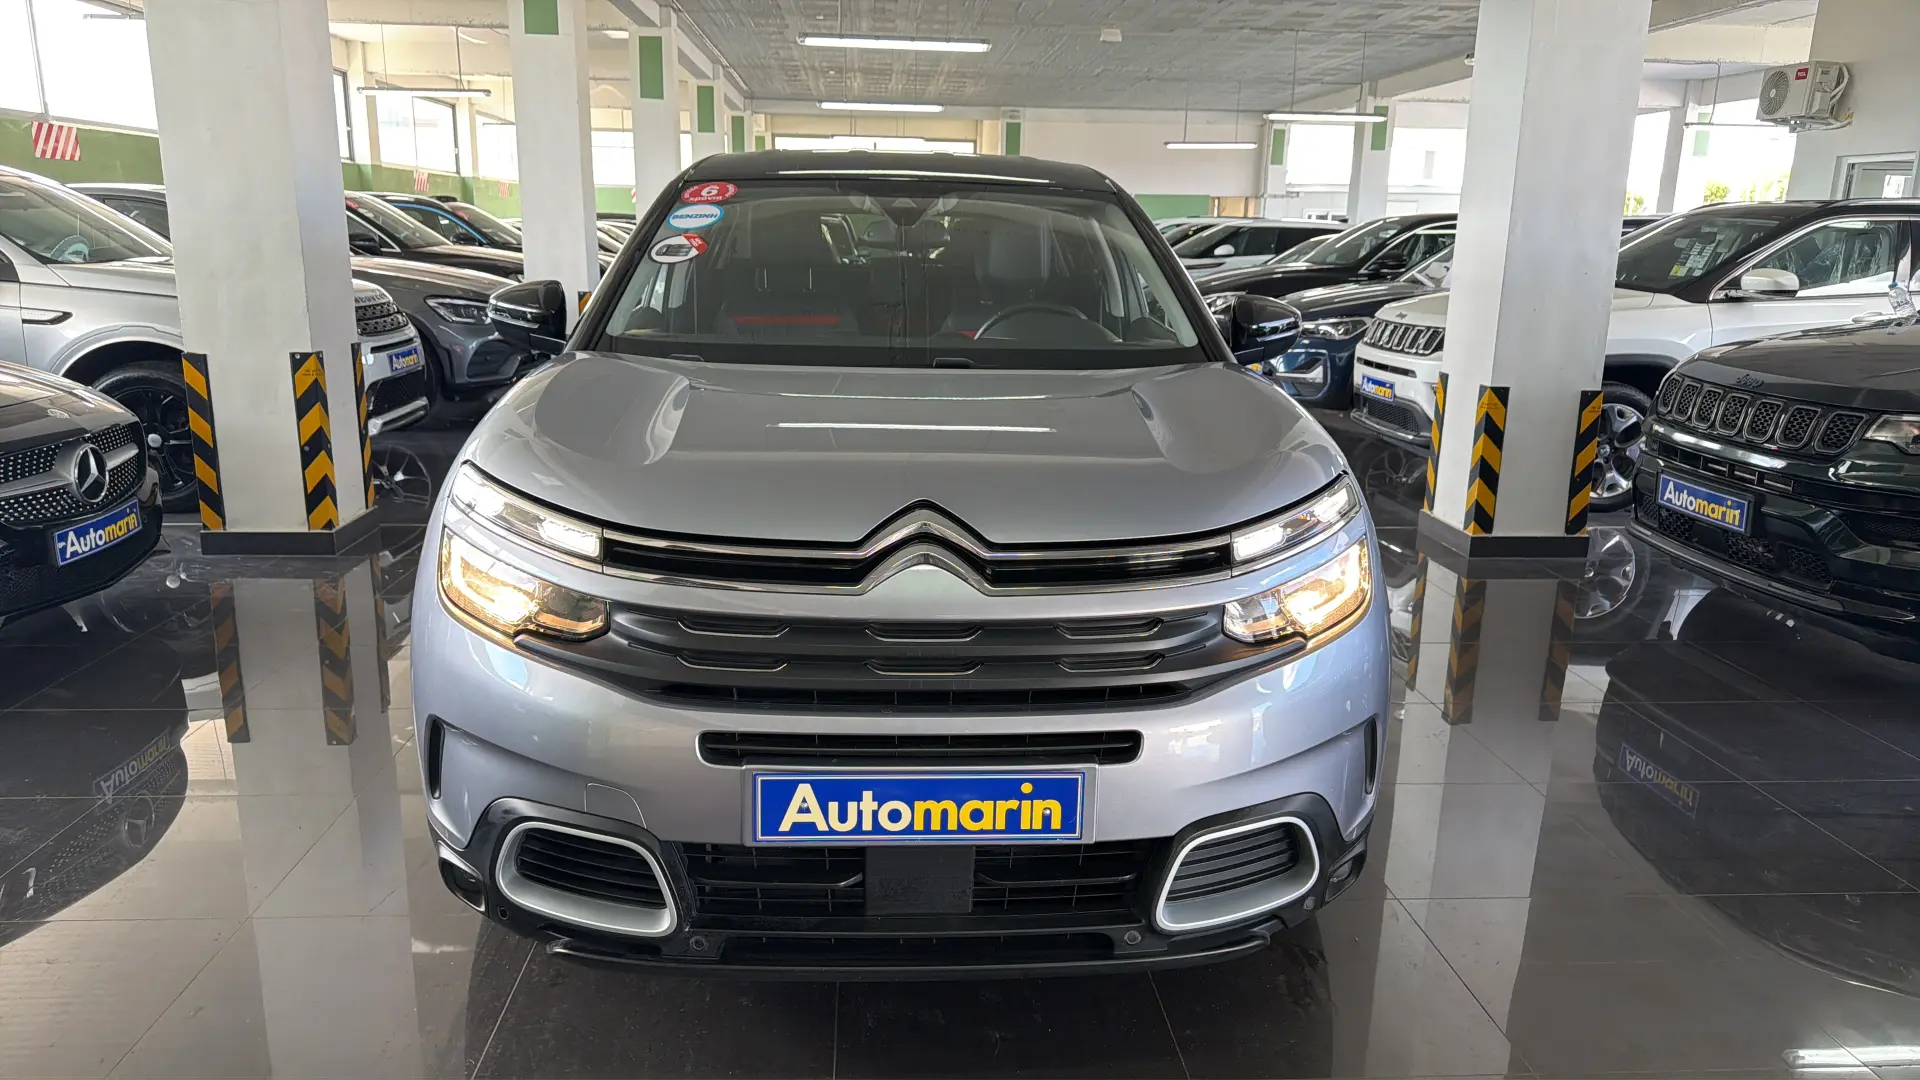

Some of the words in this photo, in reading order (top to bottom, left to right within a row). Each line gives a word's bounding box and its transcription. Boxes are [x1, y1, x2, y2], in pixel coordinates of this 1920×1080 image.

[701, 186, 719, 197] 6
[392, 350, 418, 371] Automarin
[1361, 376, 1393, 399] Automarin
[1736, 373, 1764, 388] Jeep
[1664, 481, 1740, 526] Automarin
[66, 507, 138, 559] Automarin
[778, 782, 1061, 832] Automarin
